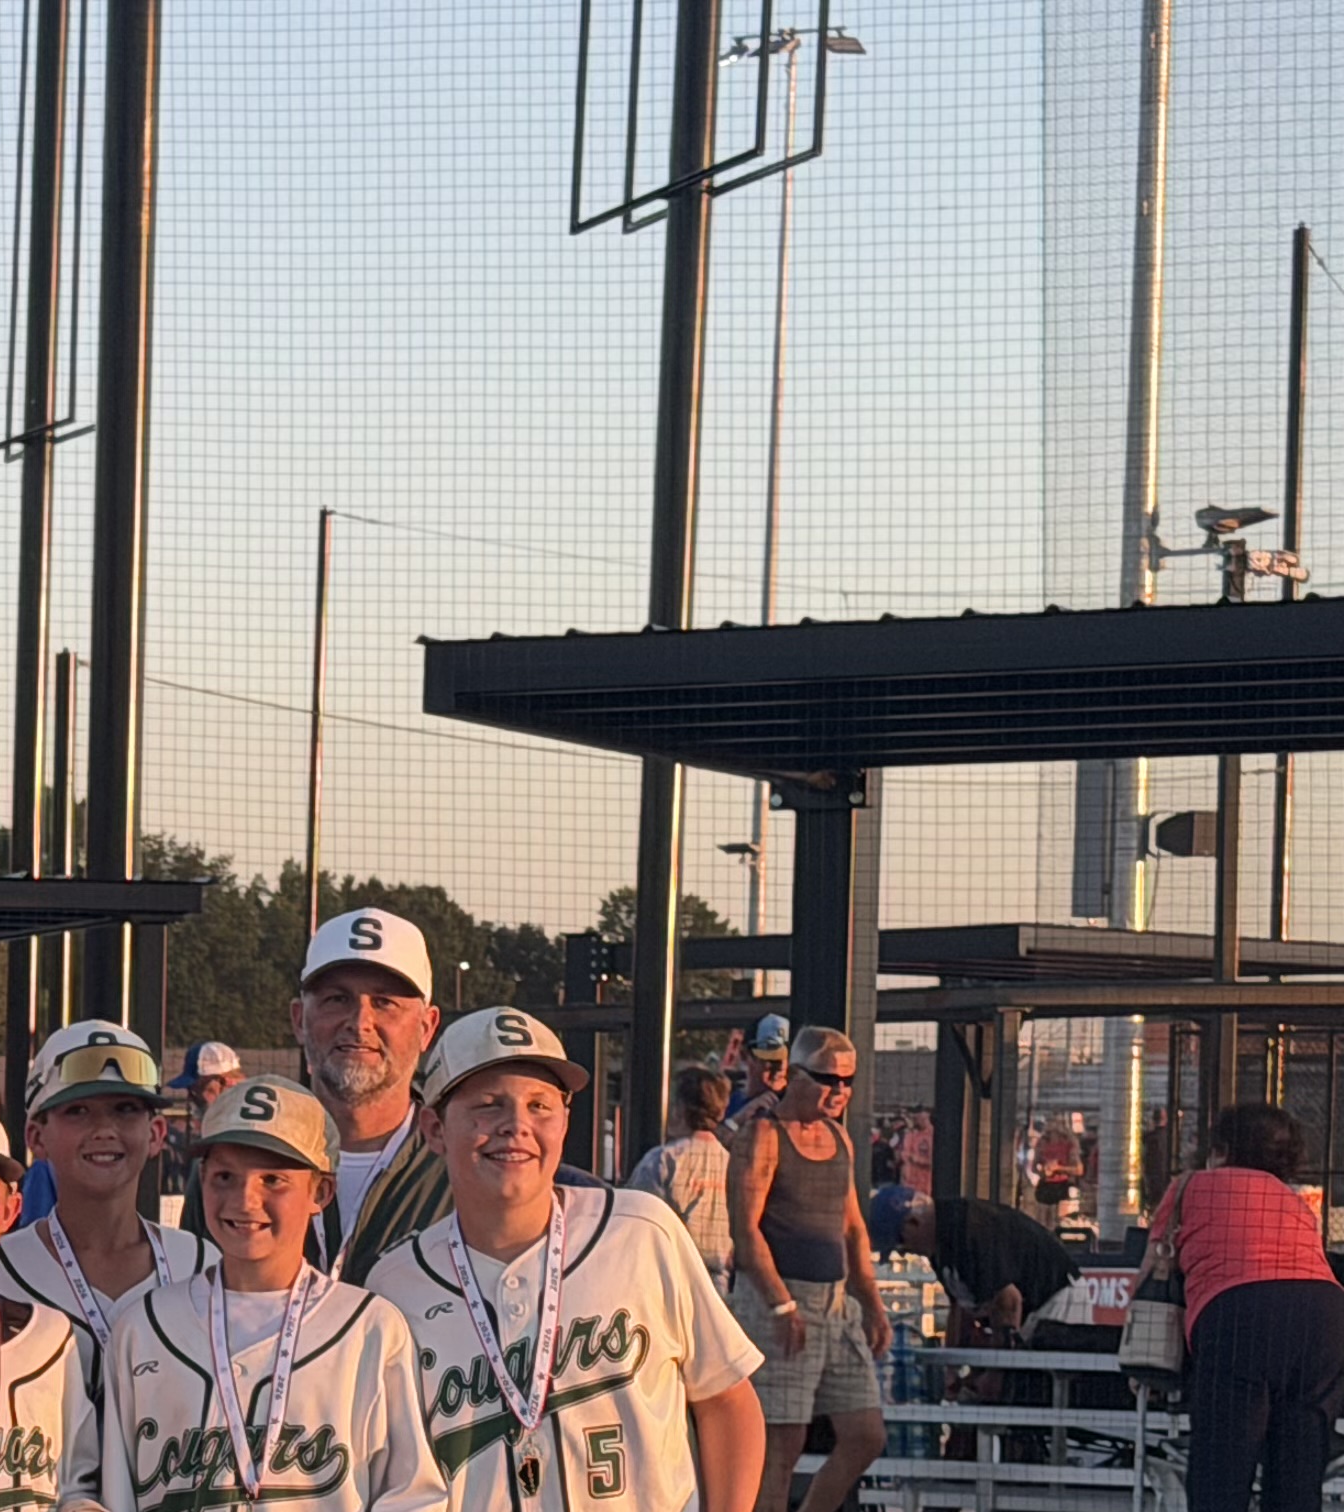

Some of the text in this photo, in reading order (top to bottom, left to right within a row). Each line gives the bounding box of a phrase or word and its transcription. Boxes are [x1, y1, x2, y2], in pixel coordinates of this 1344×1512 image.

[348, 917, 382, 951] S
[494, 1014, 533, 1047] S
[239, 1085, 277, 1121] S
[478, 1321, 491, 1344] 2026
[582, 1424, 626, 1499] 5
